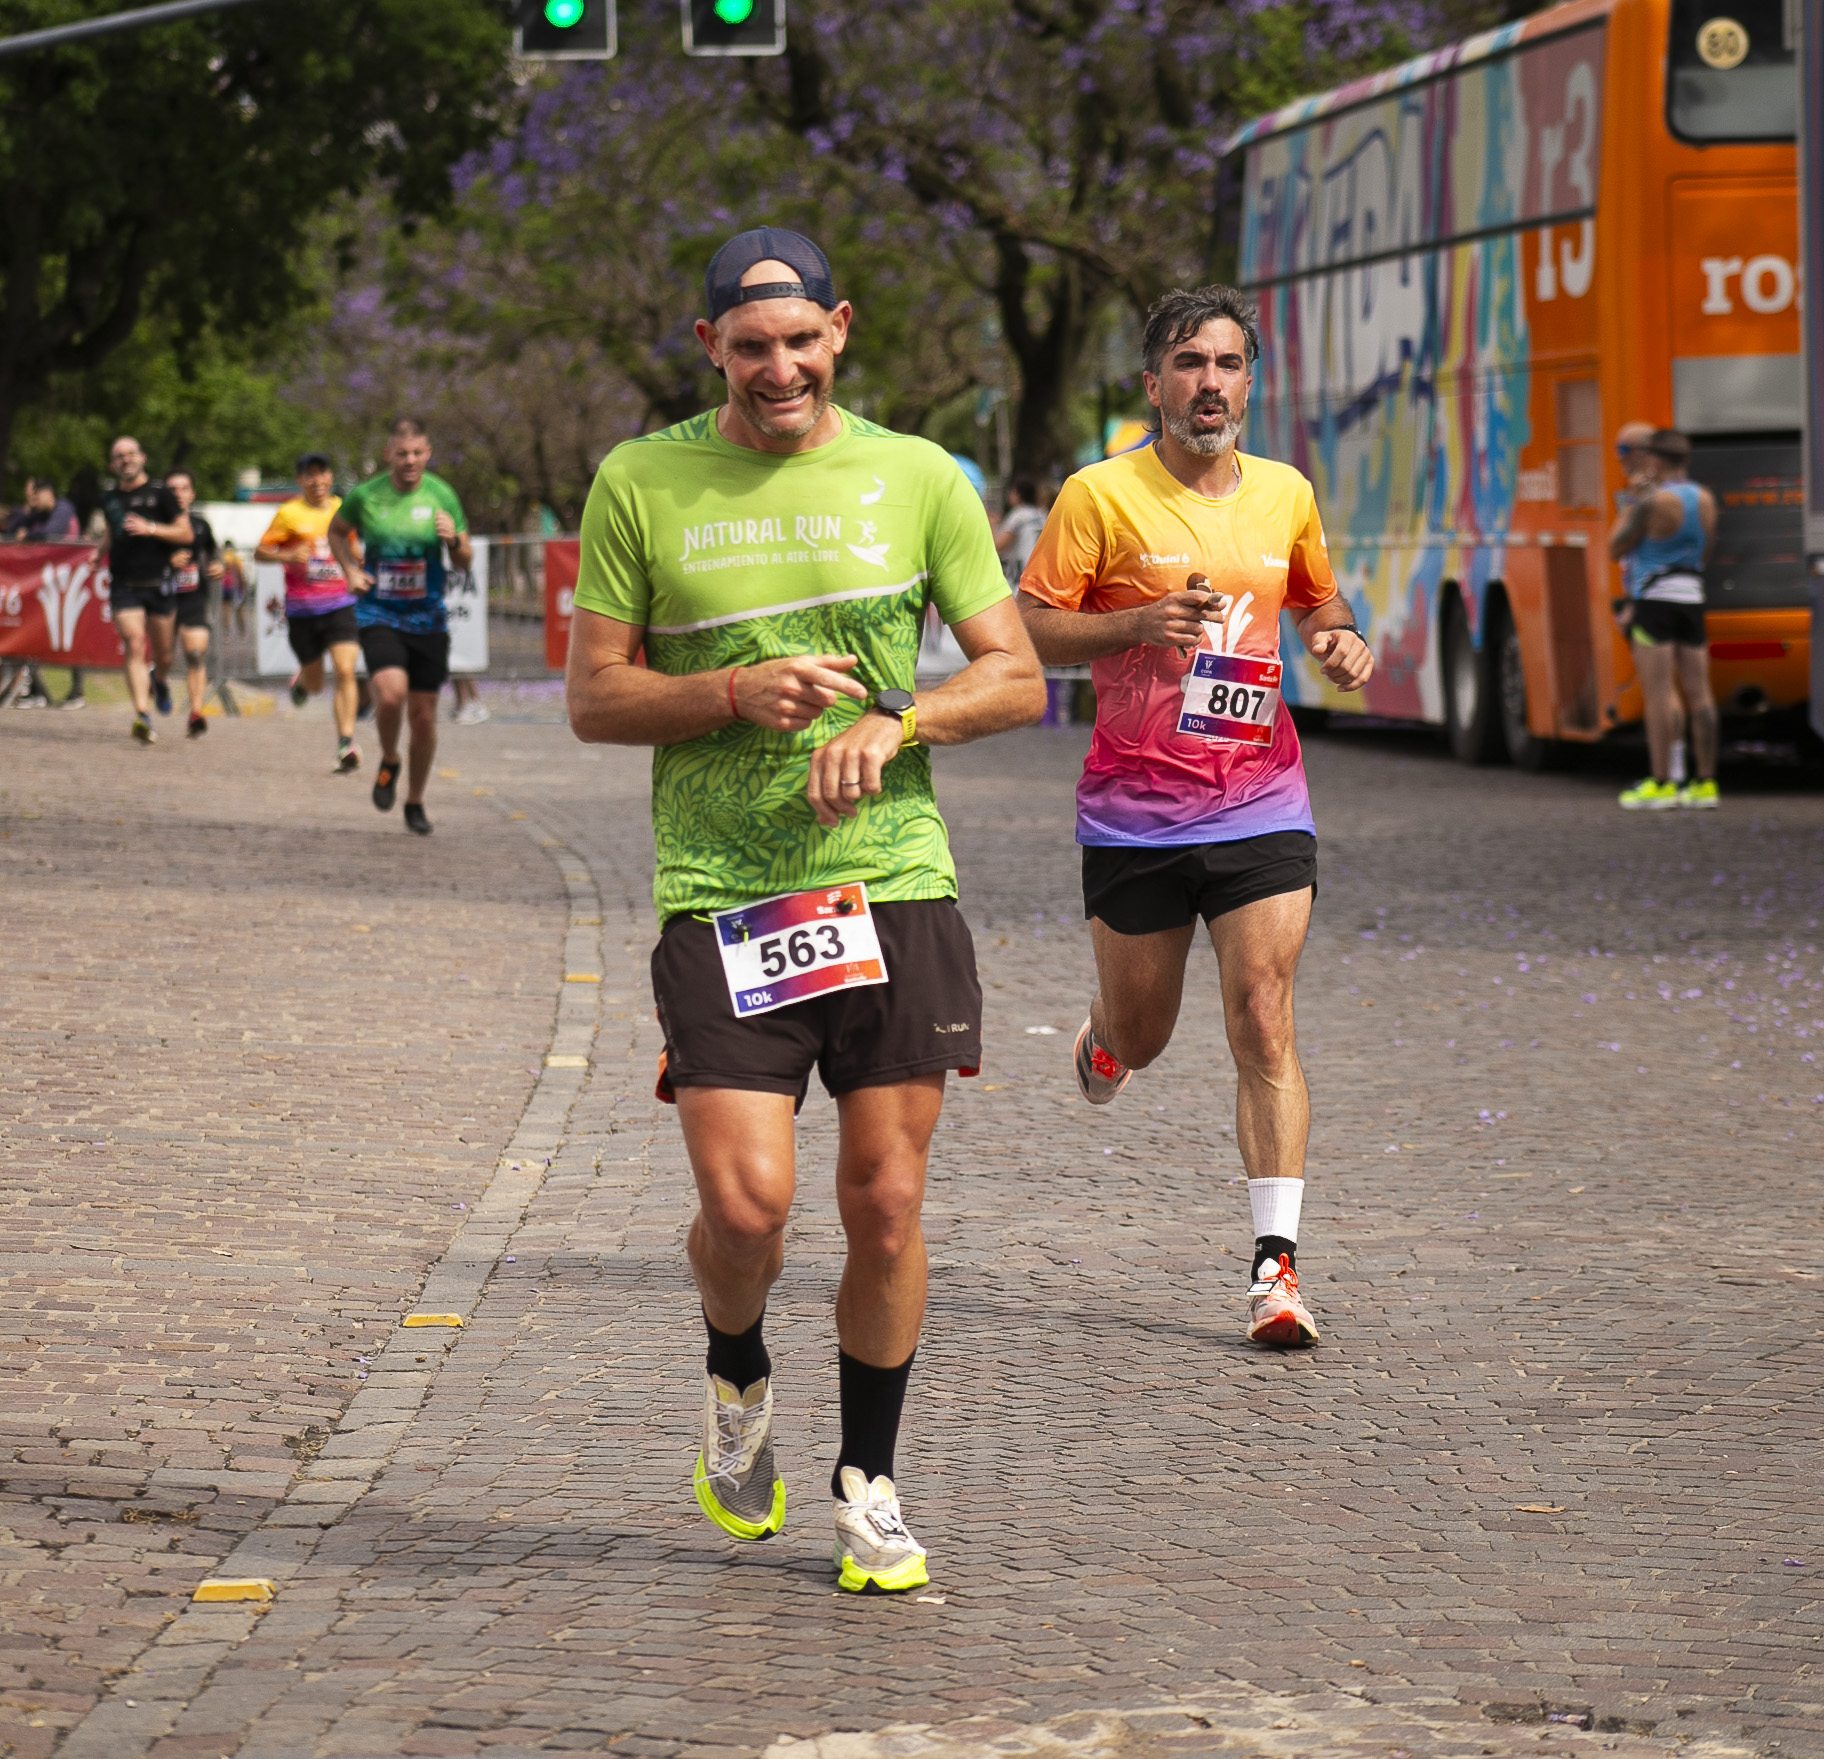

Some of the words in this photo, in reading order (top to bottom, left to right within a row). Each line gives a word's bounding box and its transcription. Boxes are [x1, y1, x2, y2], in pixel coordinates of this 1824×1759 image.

[1700, 253, 1802, 316] ro
[679, 518, 787, 563] NATURAL
[795, 514, 842, 549] RUN
[683, 552, 768, 575] ENTRENAMIENTO
[771, 552, 784, 566] AL
[786, 550, 810, 565] AIRE
[812, 549, 840, 564] LIBRE
[1207, 683, 1267, 721] 807
[1187, 718, 1207, 731] 10k
[760, 925, 845, 978] 563
[743, 990, 773, 1008] 10k
